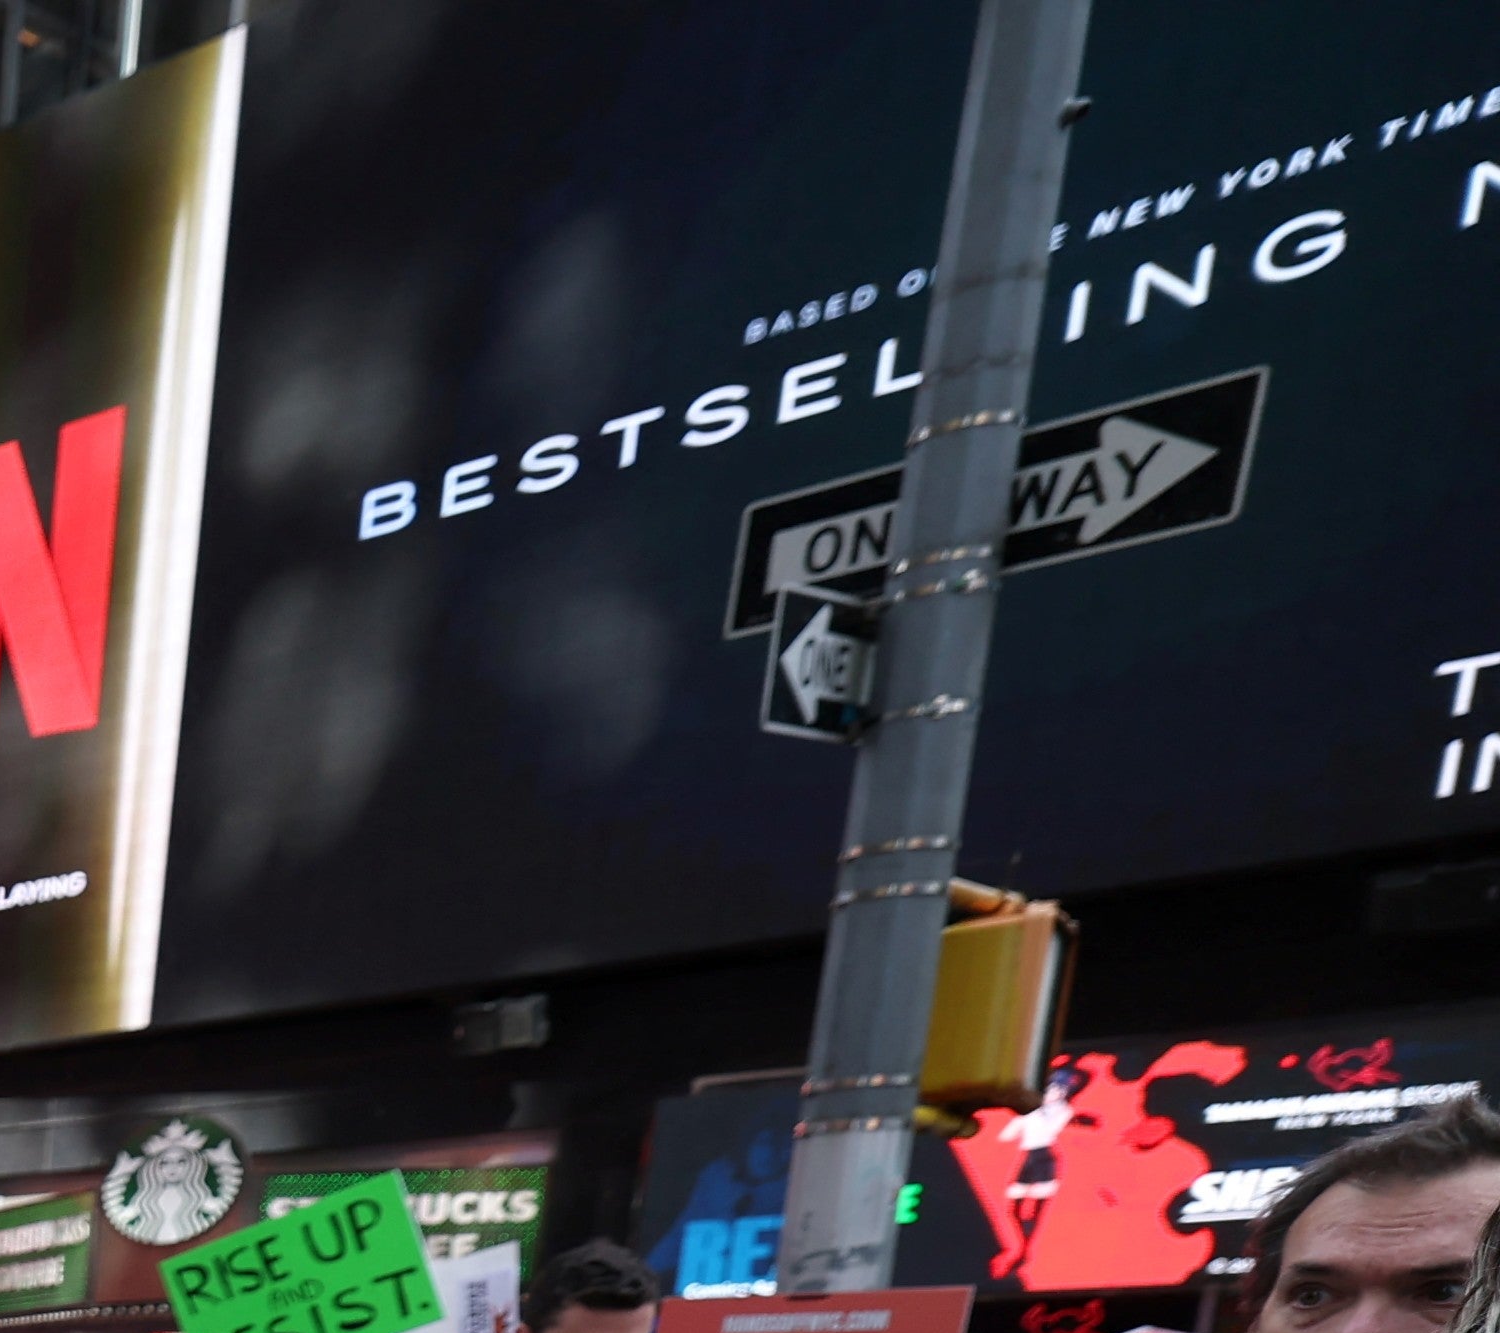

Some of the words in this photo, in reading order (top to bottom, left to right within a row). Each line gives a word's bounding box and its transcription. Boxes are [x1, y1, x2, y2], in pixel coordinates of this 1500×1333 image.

[743, 283, 878, 346] BASED
[1088, 182, 1197, 241] NEW
[1218, 132, 1353, 199] YORK
[358, 207, 1348, 542] BESTSELING
[805, 510, 894, 574] ON
[1011, 440, 1165, 525] WAY
[175, 1233, 291, 1317] RISE
[302, 1197, 383, 1264] UP
[268, 1277, 326, 1309] AND
